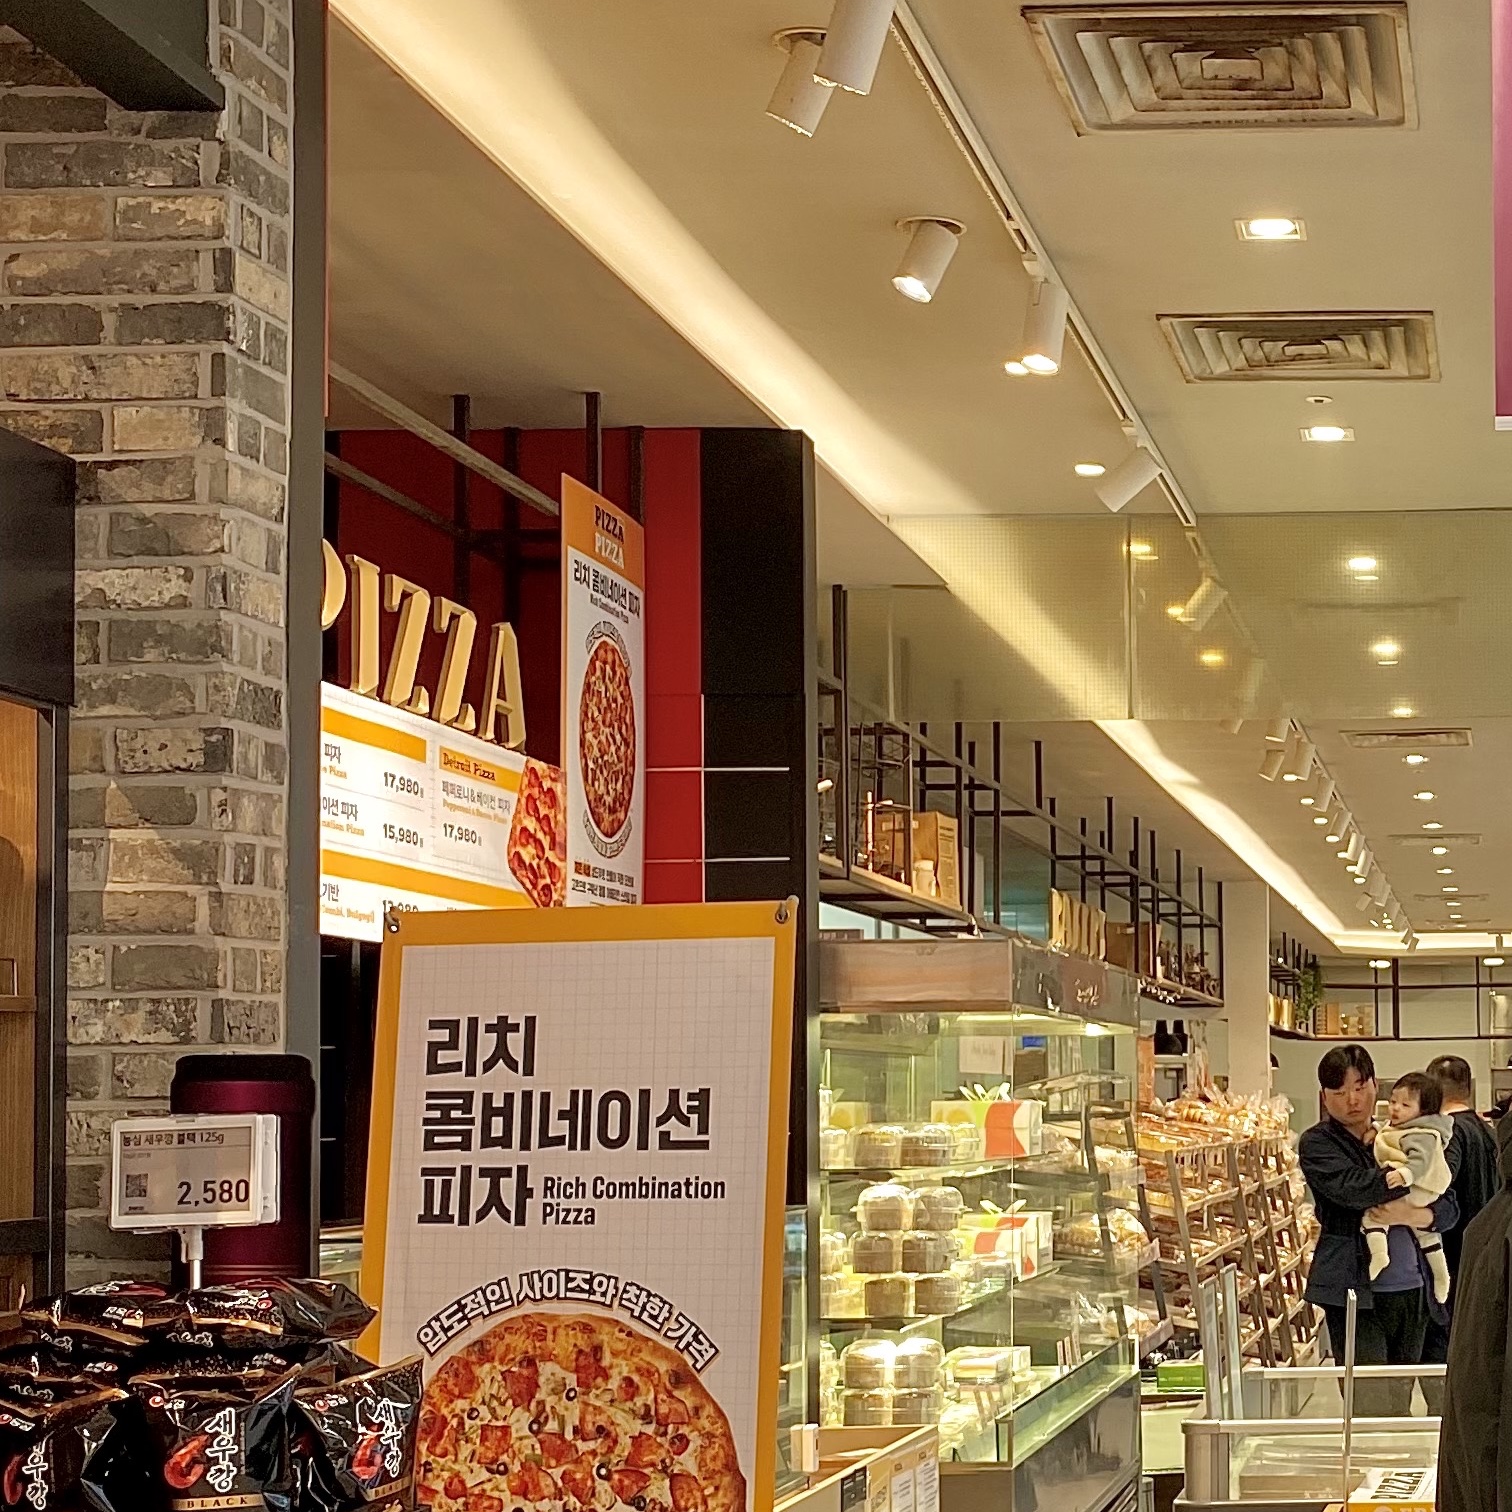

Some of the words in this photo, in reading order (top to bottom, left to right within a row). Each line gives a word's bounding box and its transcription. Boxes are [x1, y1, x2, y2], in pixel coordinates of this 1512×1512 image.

[594, 505, 625, 544] PIZZA
[594, 531, 625, 570] PIZZA
[574, 559, 590, 589] 리치
[324, 743, 342, 764] 피자
[341, 801, 358, 821] 피자
[425, 1015, 537, 1077] 리치
[422, 1087, 711, 1152] 콤비네이션
[122, 1134, 141, 1147] 농심
[144, 1133, 173, 1146] 새우깡
[200, 1132, 225, 1144] 125g
[177, 1179, 250, 1206] 2,580
[417, 1165, 534, 1227] 피자
[542, 1176, 587, 1199] Rich
[592, 1176, 726, 1200] Combination
[542, 1202, 596, 1226] Pizza
[417, 1277, 512, 1356] 압도적인
[516, 1268, 618, 1306] 사이즈와
[620, 1281, 673, 1334] 착한
[666, 1311, 720, 1373] 가격
[205, 1407, 238, 1493] 새우깡
[1370, 1471, 1427, 1500] PIZZA
[186, 1496, 248, 1508] BLACK
